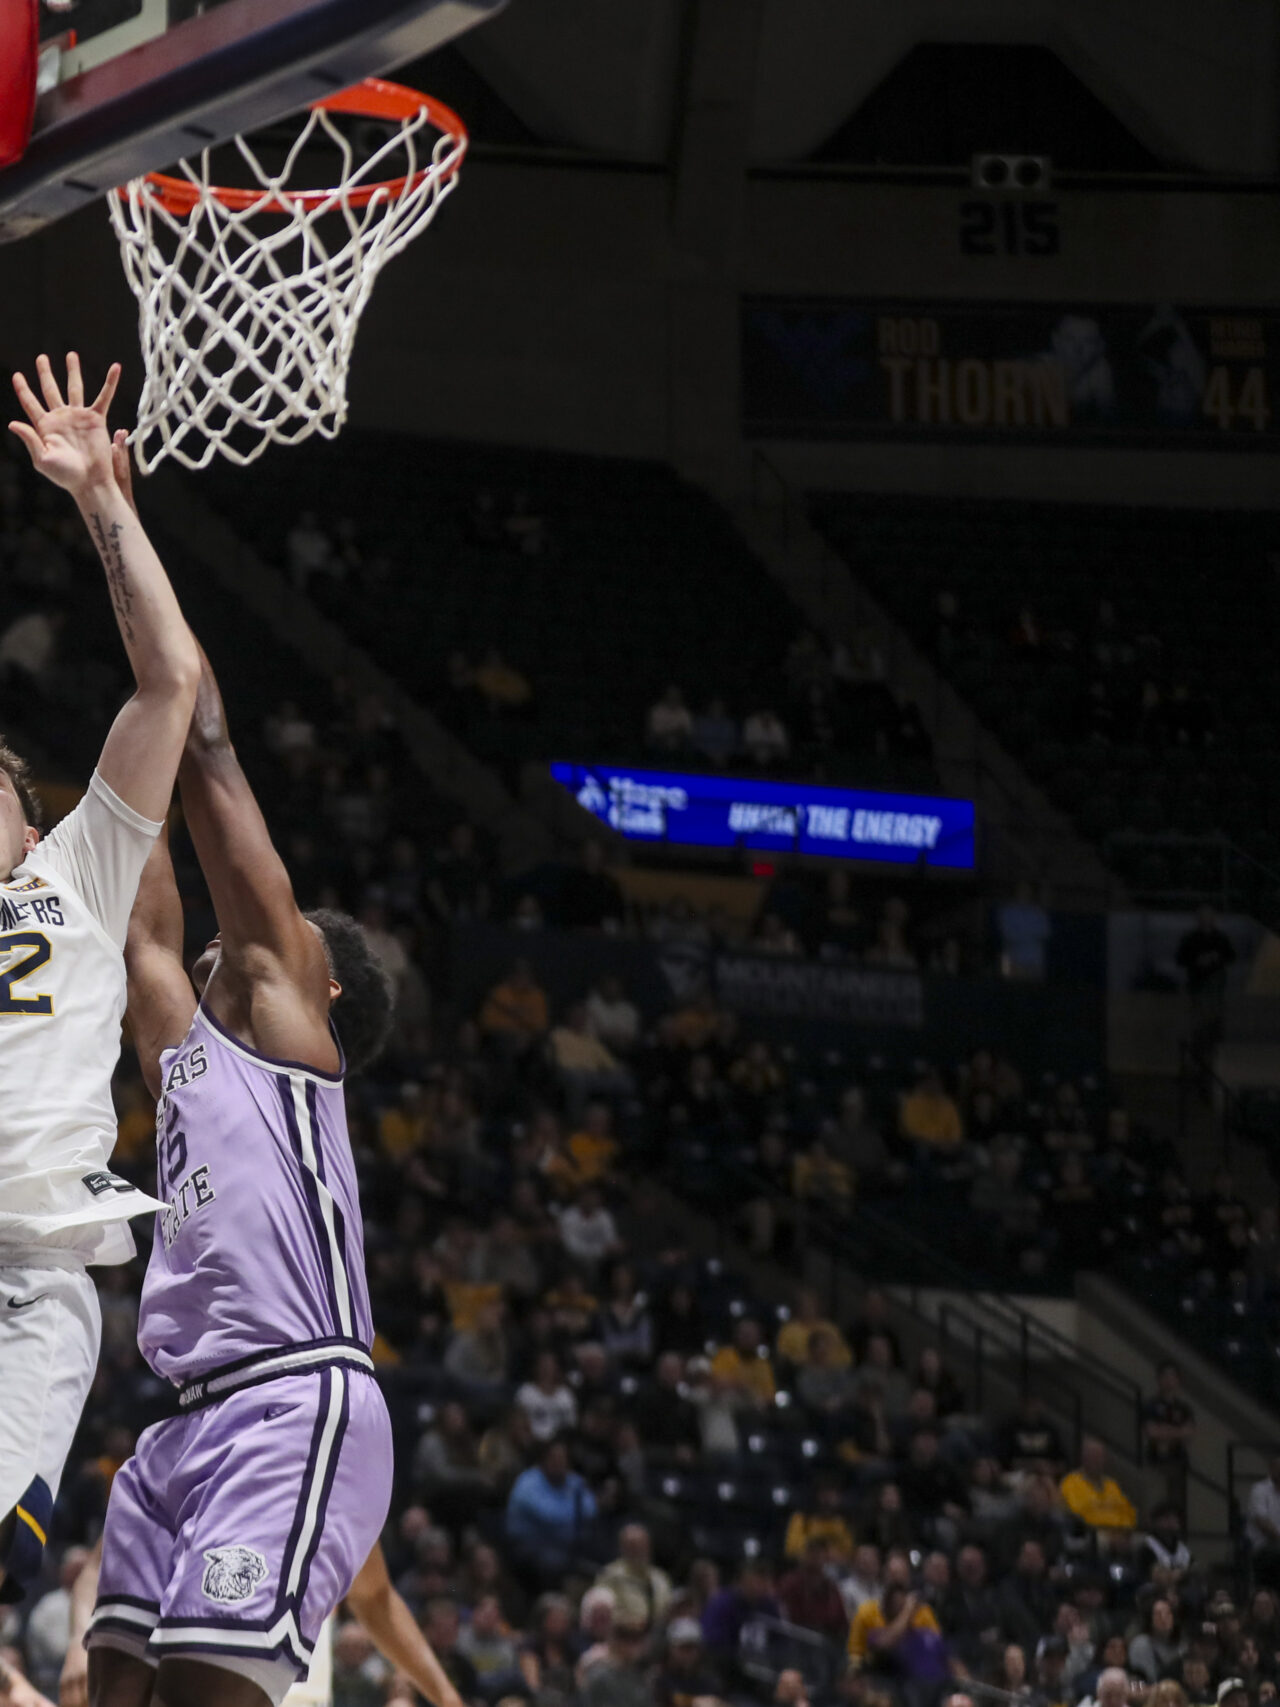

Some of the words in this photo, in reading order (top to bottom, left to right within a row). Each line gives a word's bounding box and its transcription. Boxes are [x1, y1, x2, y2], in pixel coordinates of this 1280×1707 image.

[959, 201, 1060, 255] 215
[879, 356, 1072, 428] THORN
[1201, 364, 1271, 431] 44
[806, 803, 852, 842] THE
[851, 807, 943, 850] ENERGY
